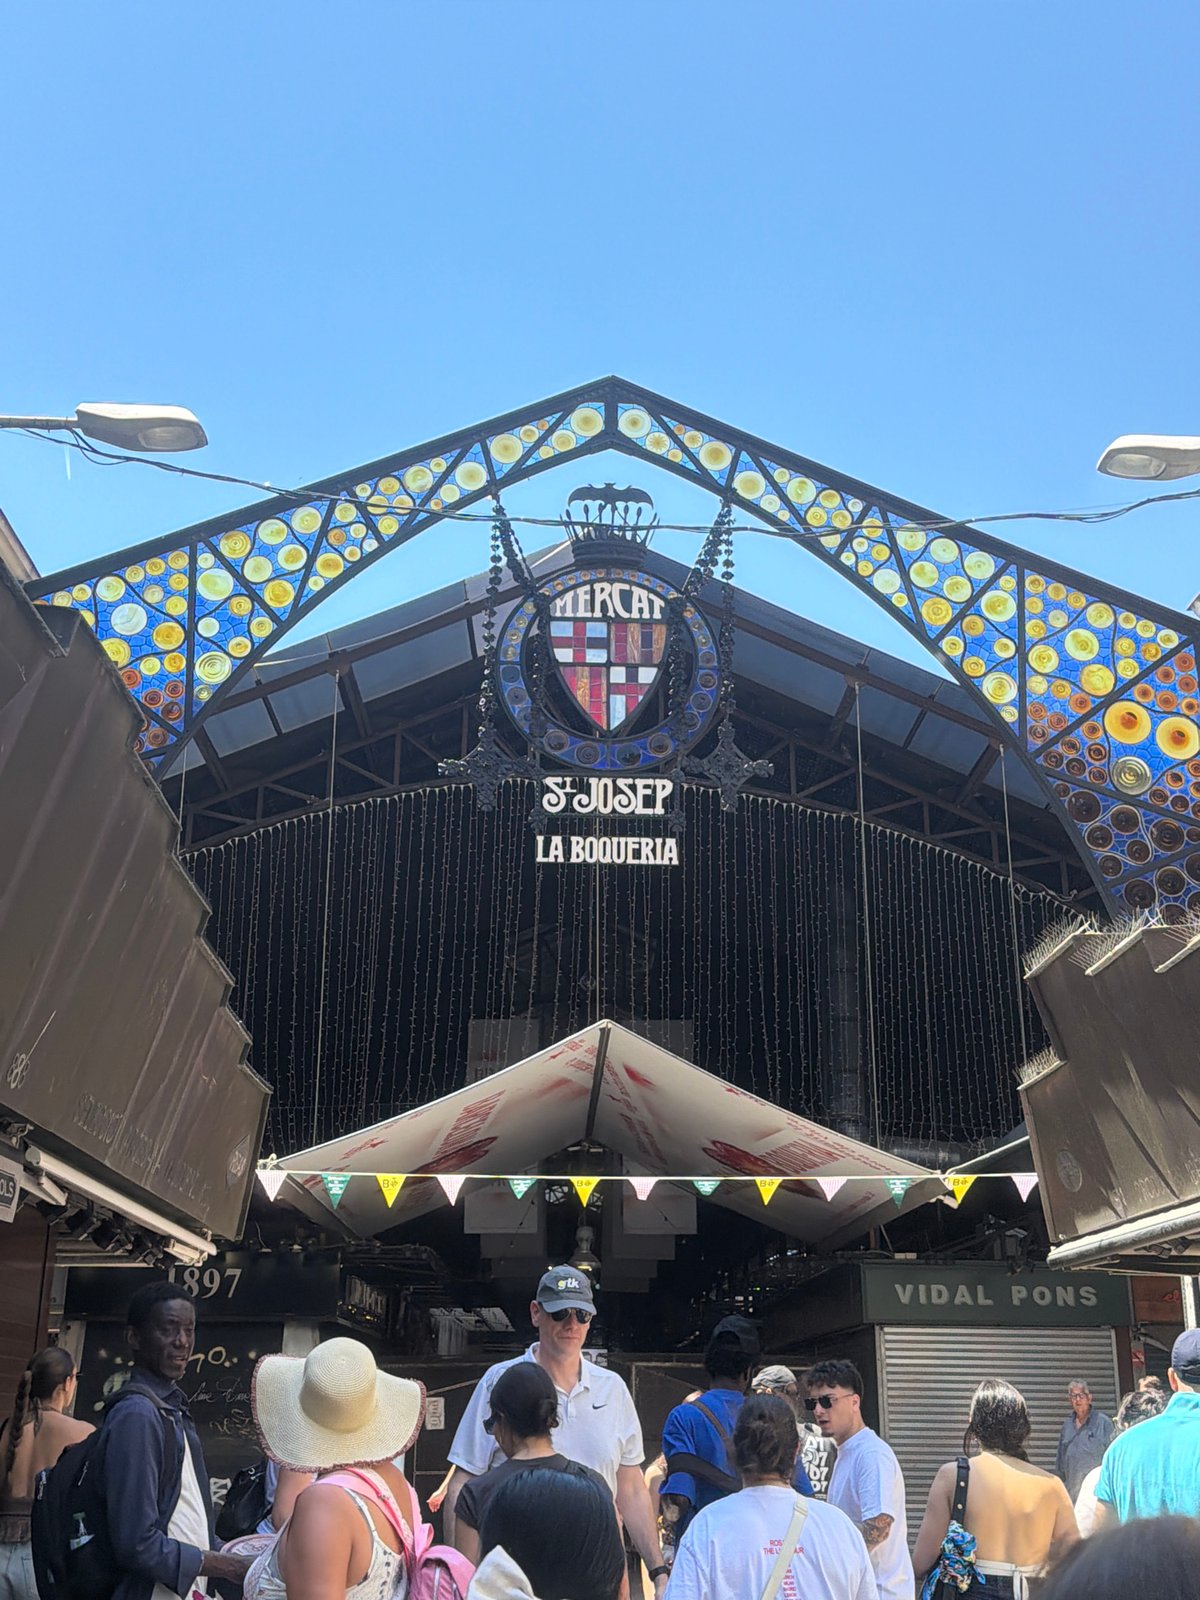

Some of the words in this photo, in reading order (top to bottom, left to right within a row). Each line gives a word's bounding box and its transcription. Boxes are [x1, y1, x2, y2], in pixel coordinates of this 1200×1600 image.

[555, 581, 665, 620] MERCAT
[572, 776, 673, 815] JOSEP
[536, 835, 565, 863] LA
[570, 835, 679, 866] BOQUERIA
[168, 1264, 242, 1299] 1897
[557, 1277, 580, 1290] gtk
[894, 1284, 994, 1306] VIDAL
[1011, 1285, 1099, 1307] PONS
